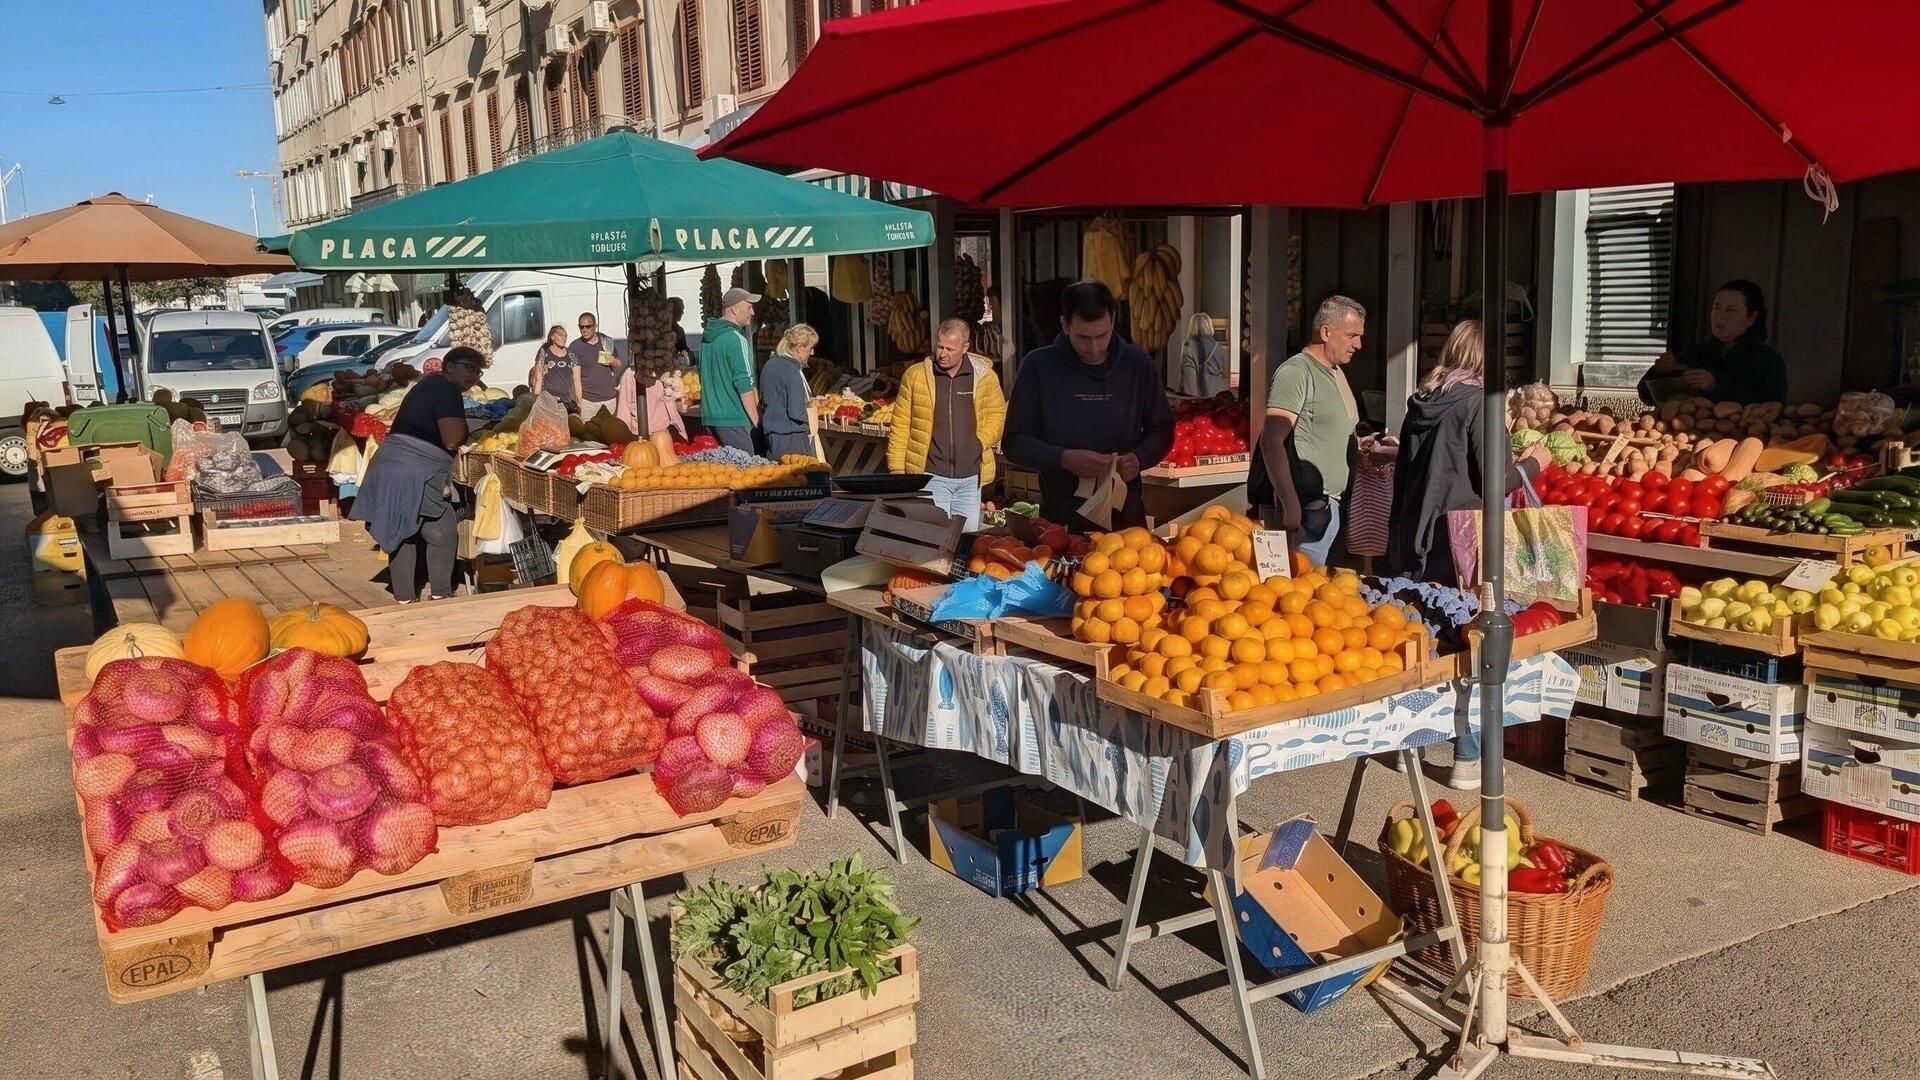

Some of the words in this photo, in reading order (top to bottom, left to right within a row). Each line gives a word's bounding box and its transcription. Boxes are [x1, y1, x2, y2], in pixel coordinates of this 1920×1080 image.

[321, 237, 417, 260] PLACA
[675, 227, 760, 250] PLACA
[749, 822, 783, 842] EPAL
[130, 960, 181, 984] EPAL
